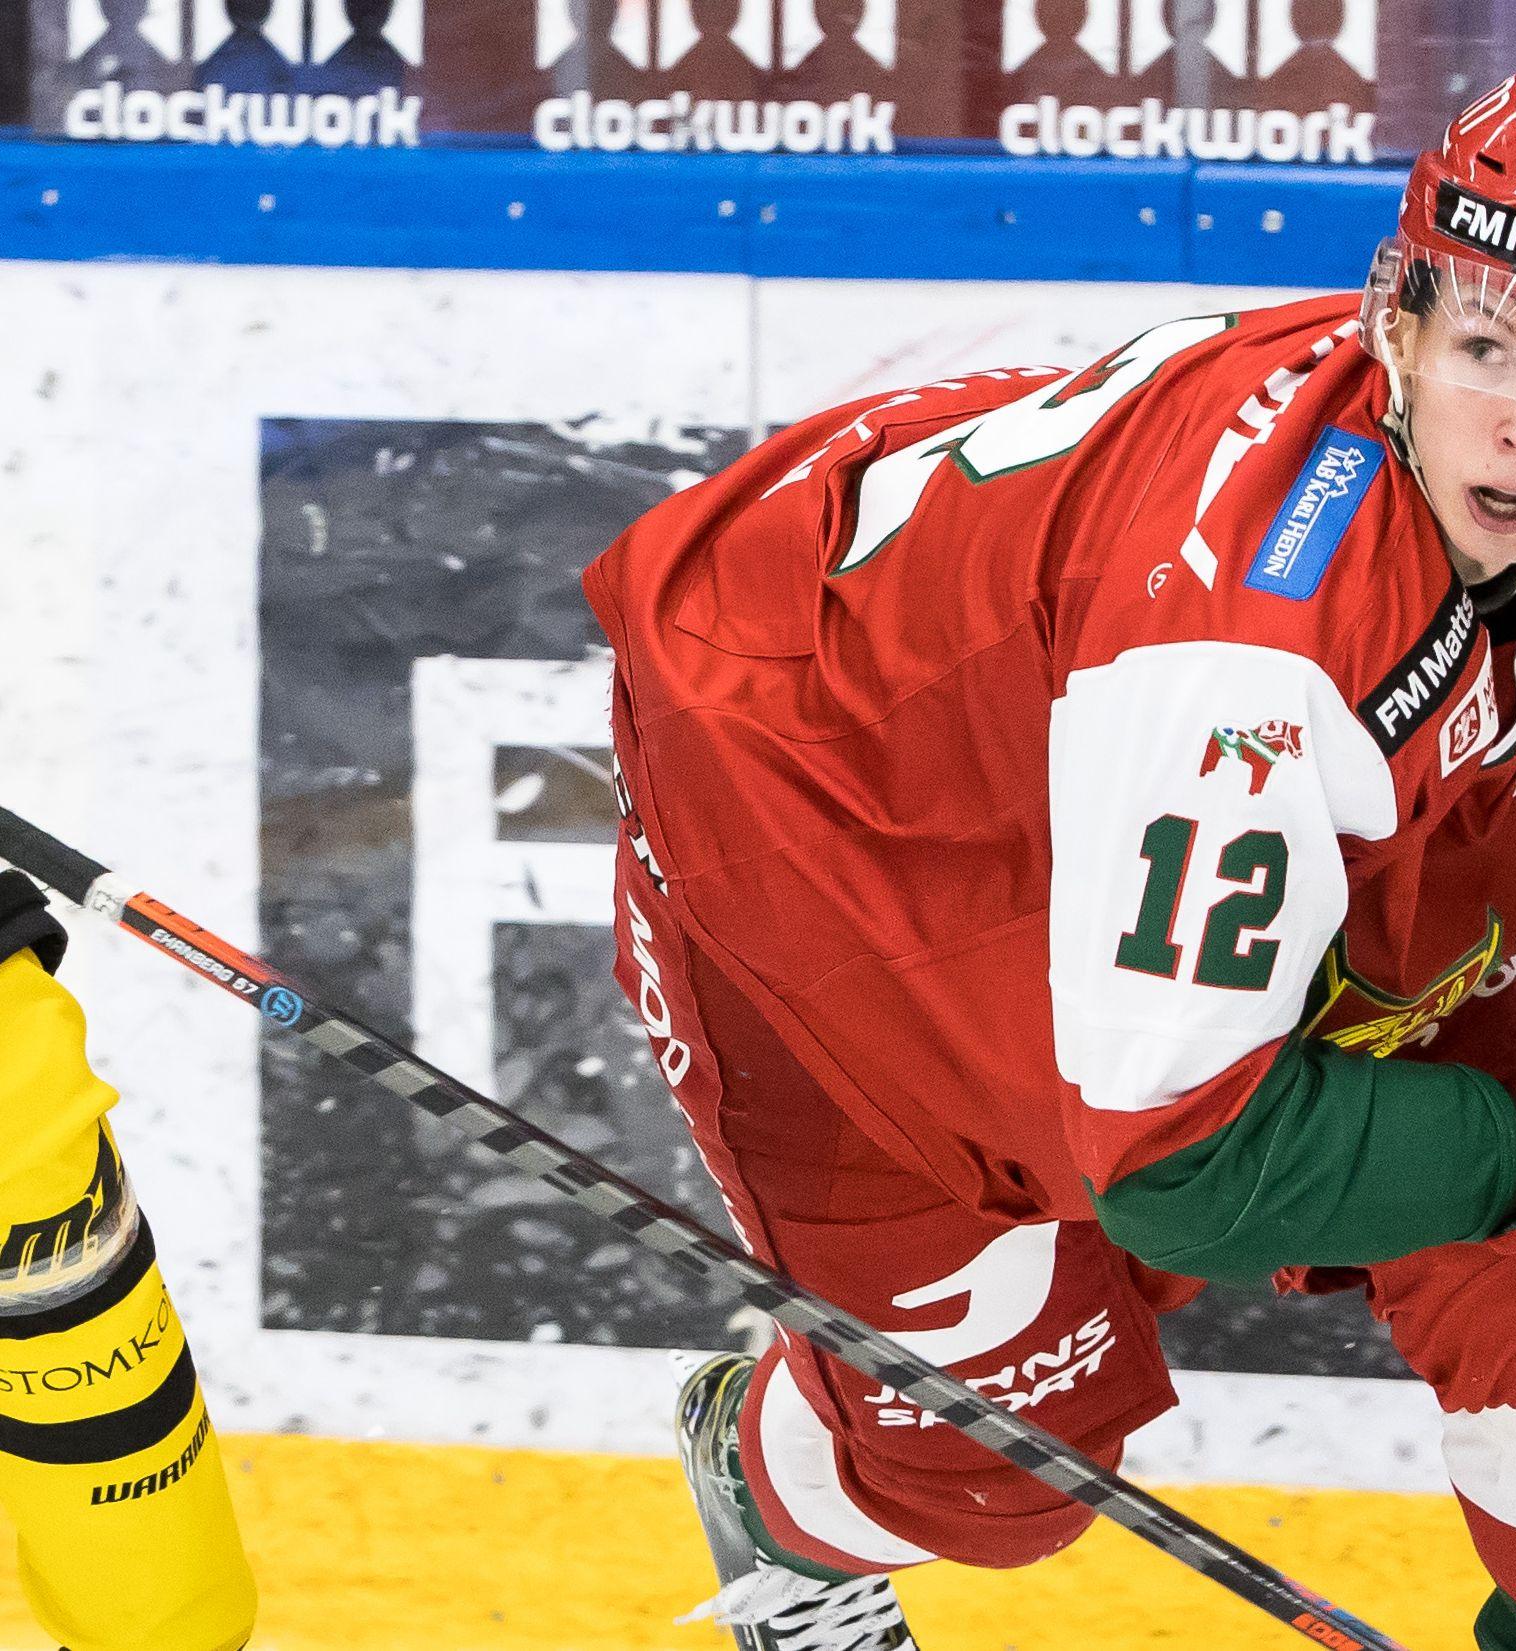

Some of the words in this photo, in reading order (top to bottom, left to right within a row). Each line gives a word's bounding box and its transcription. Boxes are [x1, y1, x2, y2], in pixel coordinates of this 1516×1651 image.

[65, 82, 422, 148] clockwork
[534, 91, 896, 153] clockwork
[1001, 95, 1376, 163] clockwork
[1450, 196, 1506, 246] FM
[1291, 478, 1330, 521] KARL
[1263, 519, 1307, 577] HEDIN
[1375, 670, 1431, 738] FM
[1419, 588, 1474, 689] Matts
[412, 655, 618, 1100] F
[1114, 813, 1289, 991] 12
[0, 1284, 171, 1395] STOMKO
[863, 1308, 1111, 1404] JHNS
